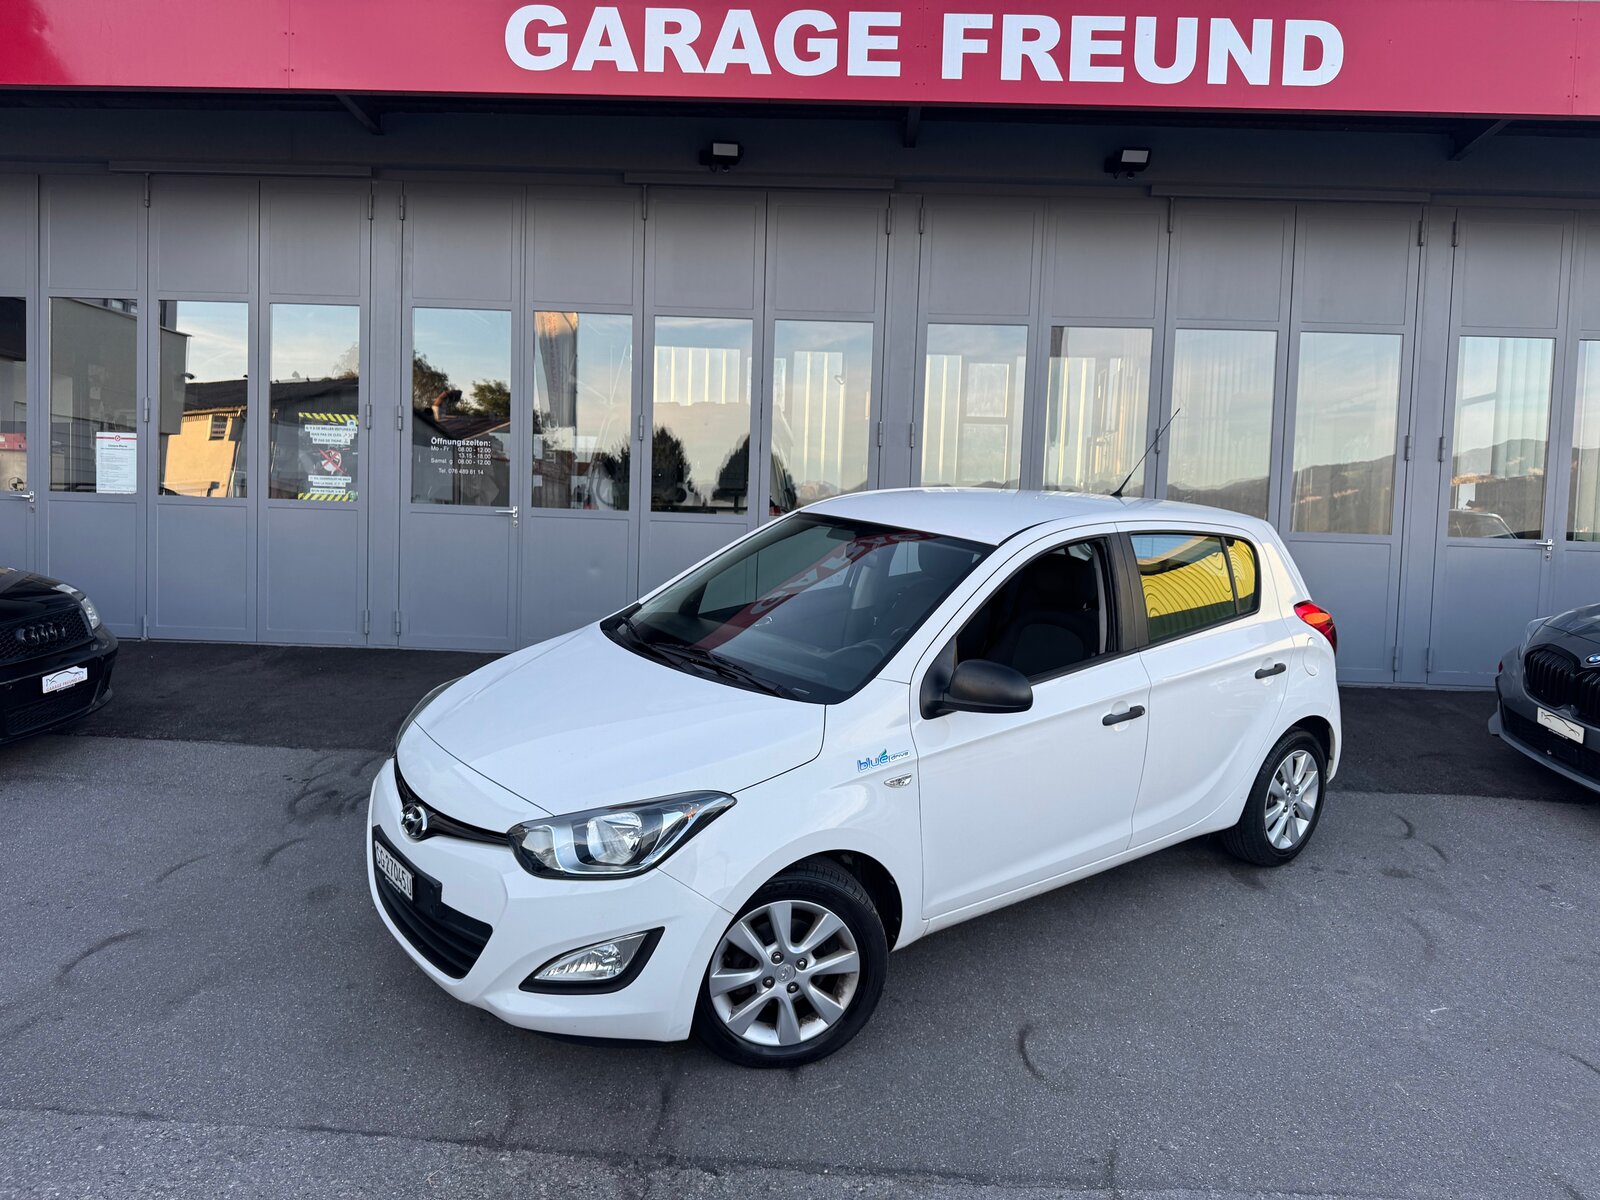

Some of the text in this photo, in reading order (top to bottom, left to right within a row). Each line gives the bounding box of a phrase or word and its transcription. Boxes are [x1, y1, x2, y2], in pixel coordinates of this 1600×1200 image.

[504, 4, 1345, 87] GARAGE FREUND
[857, 751, 889, 771] blue
